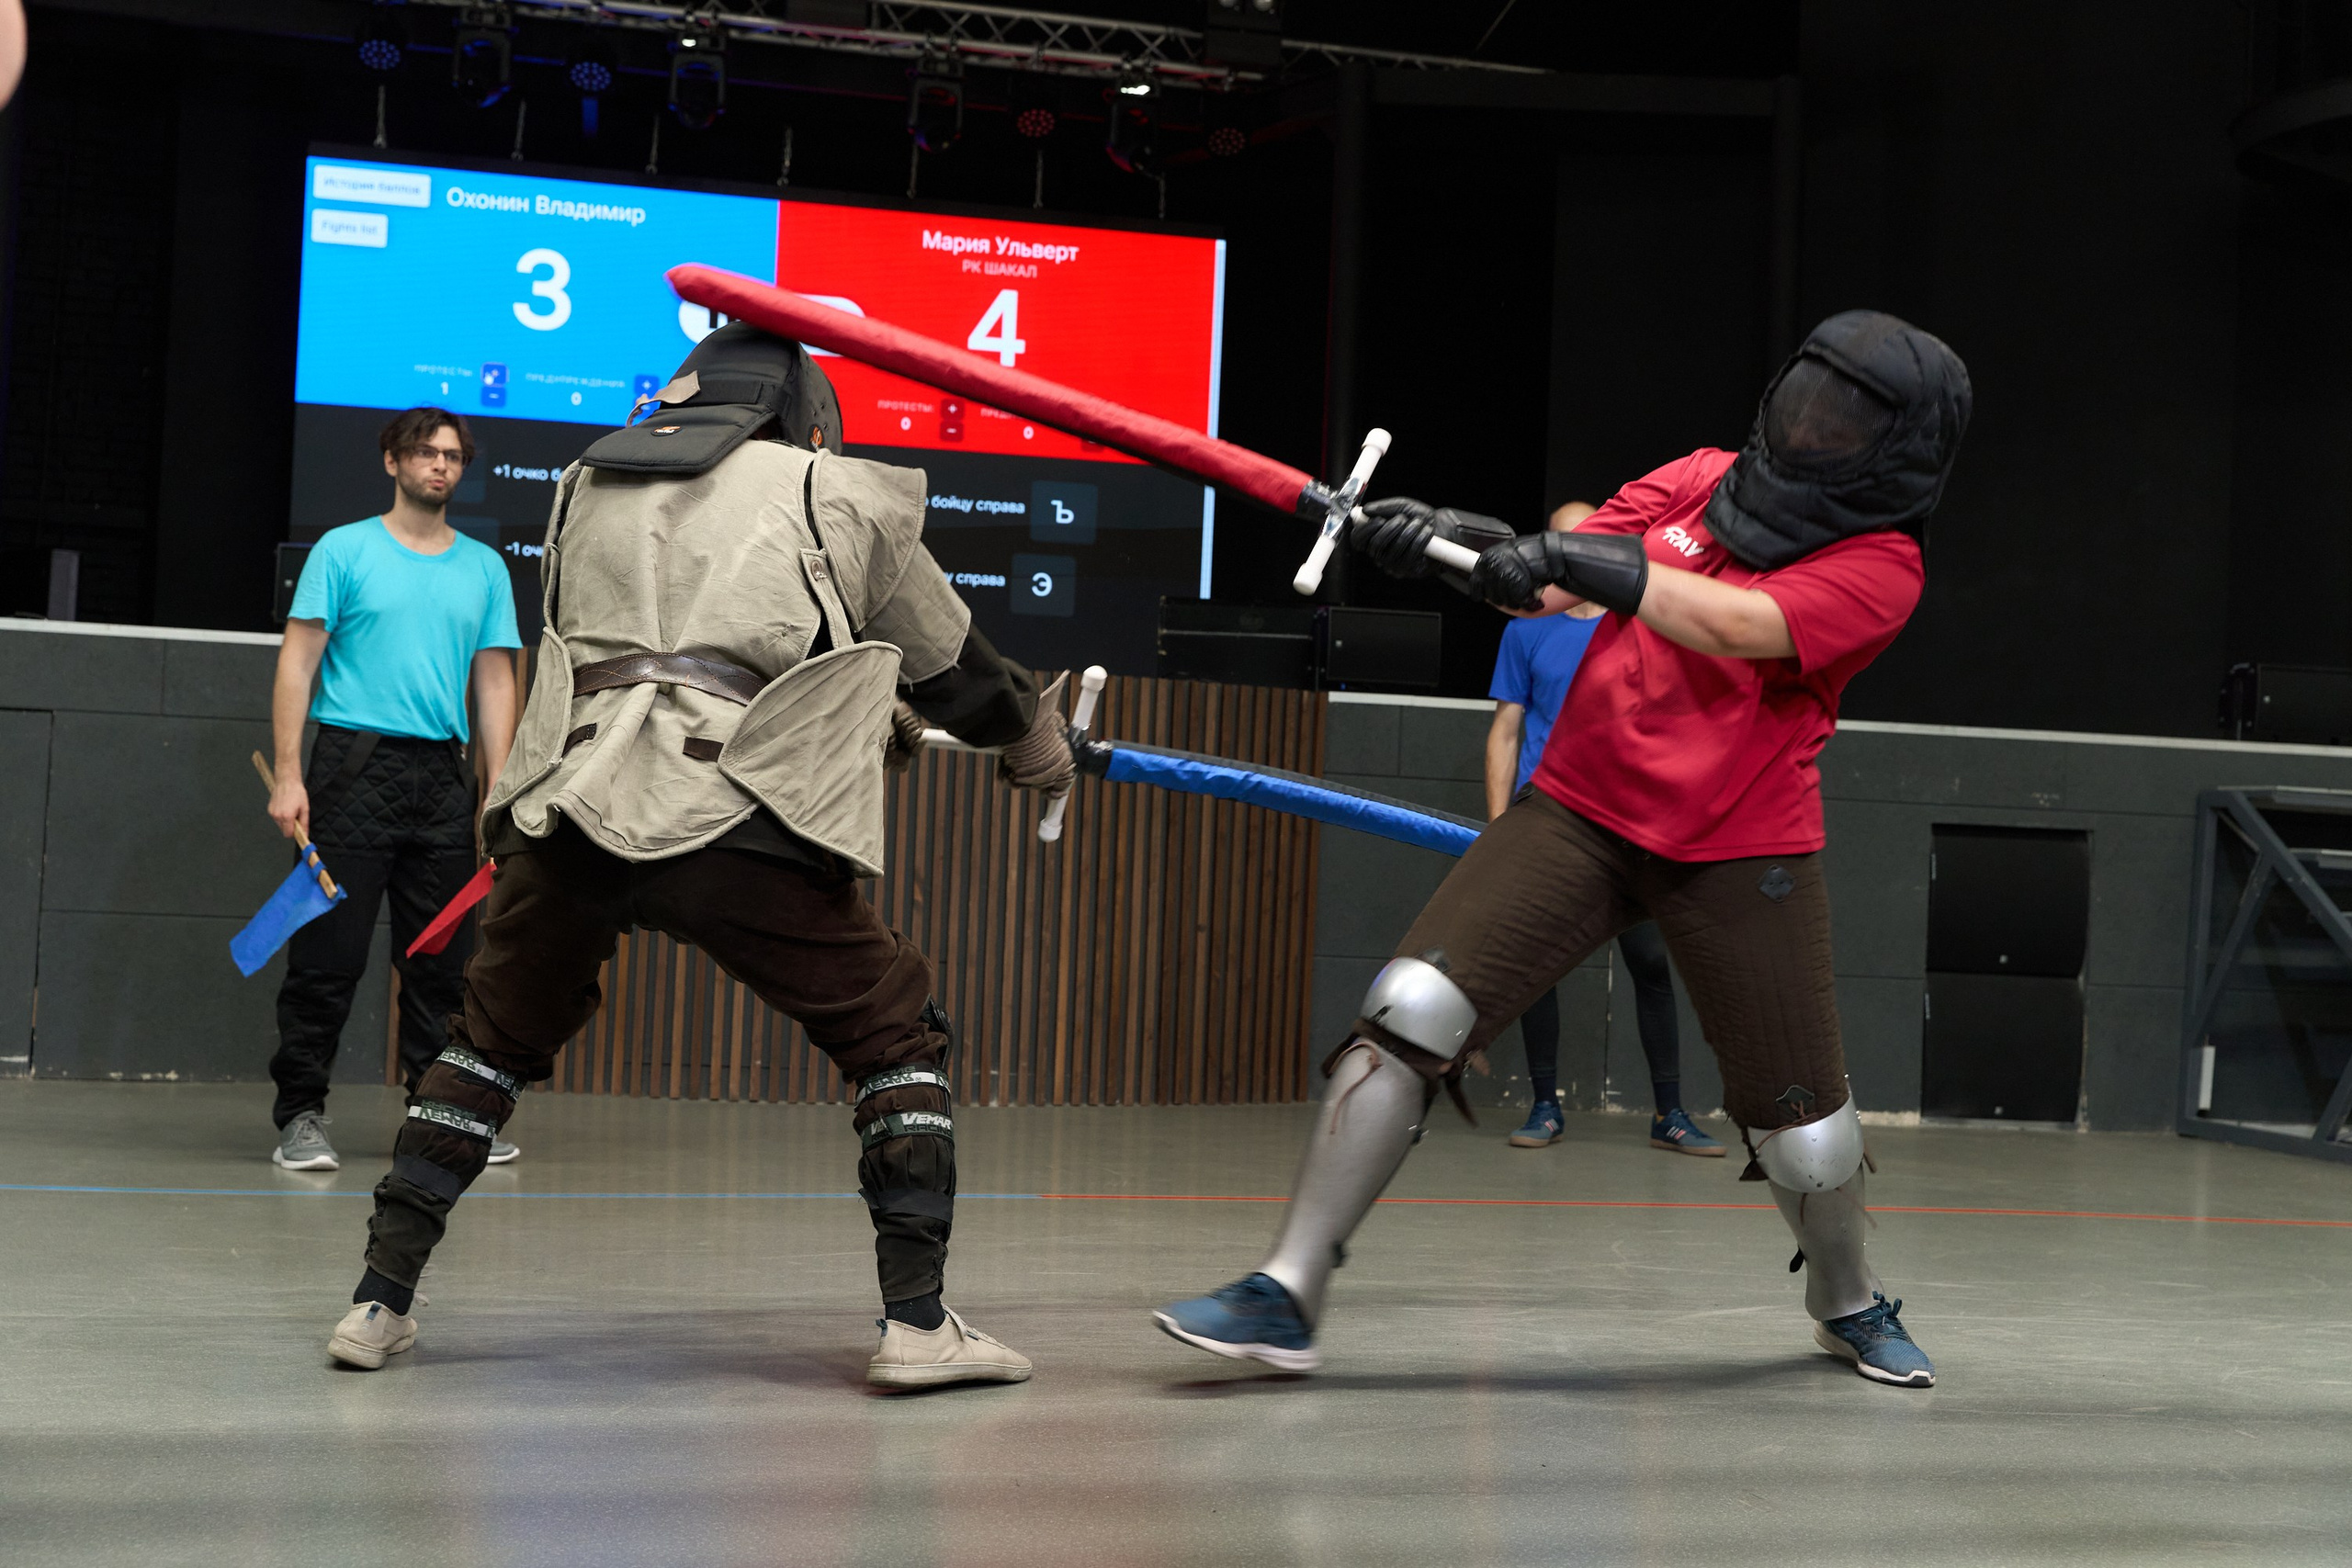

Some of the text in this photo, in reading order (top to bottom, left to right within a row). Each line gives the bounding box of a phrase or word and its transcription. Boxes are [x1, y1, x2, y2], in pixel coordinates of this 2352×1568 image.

[447, 186, 646, 227] Охонин Владимир
[922, 230, 1080, 265] Мария Ульверт
[962, 259, 1037, 278] РК ШАКАЛ
[513, 247, 571, 331] 3
[967, 288, 1025, 367] 4
[441, 381, 449, 396] 1
[571, 391, 582, 406] 0
[900, 416, 912, 431] 0
[1023, 425, 1035, 440] 0
[492, 463, 511, 479] +1
[512, 467, 549, 481] очко
[931, 493, 974, 513] бойцу
[975, 499, 1026, 515] справа
[1050, 499, 1075, 525] Ъ
[504, 541, 520, 557] -1
[955, 571, 1006, 588] справа
[1031, 571, 1053, 597] Э
[900, 1112, 951, 1130] VEMAR
